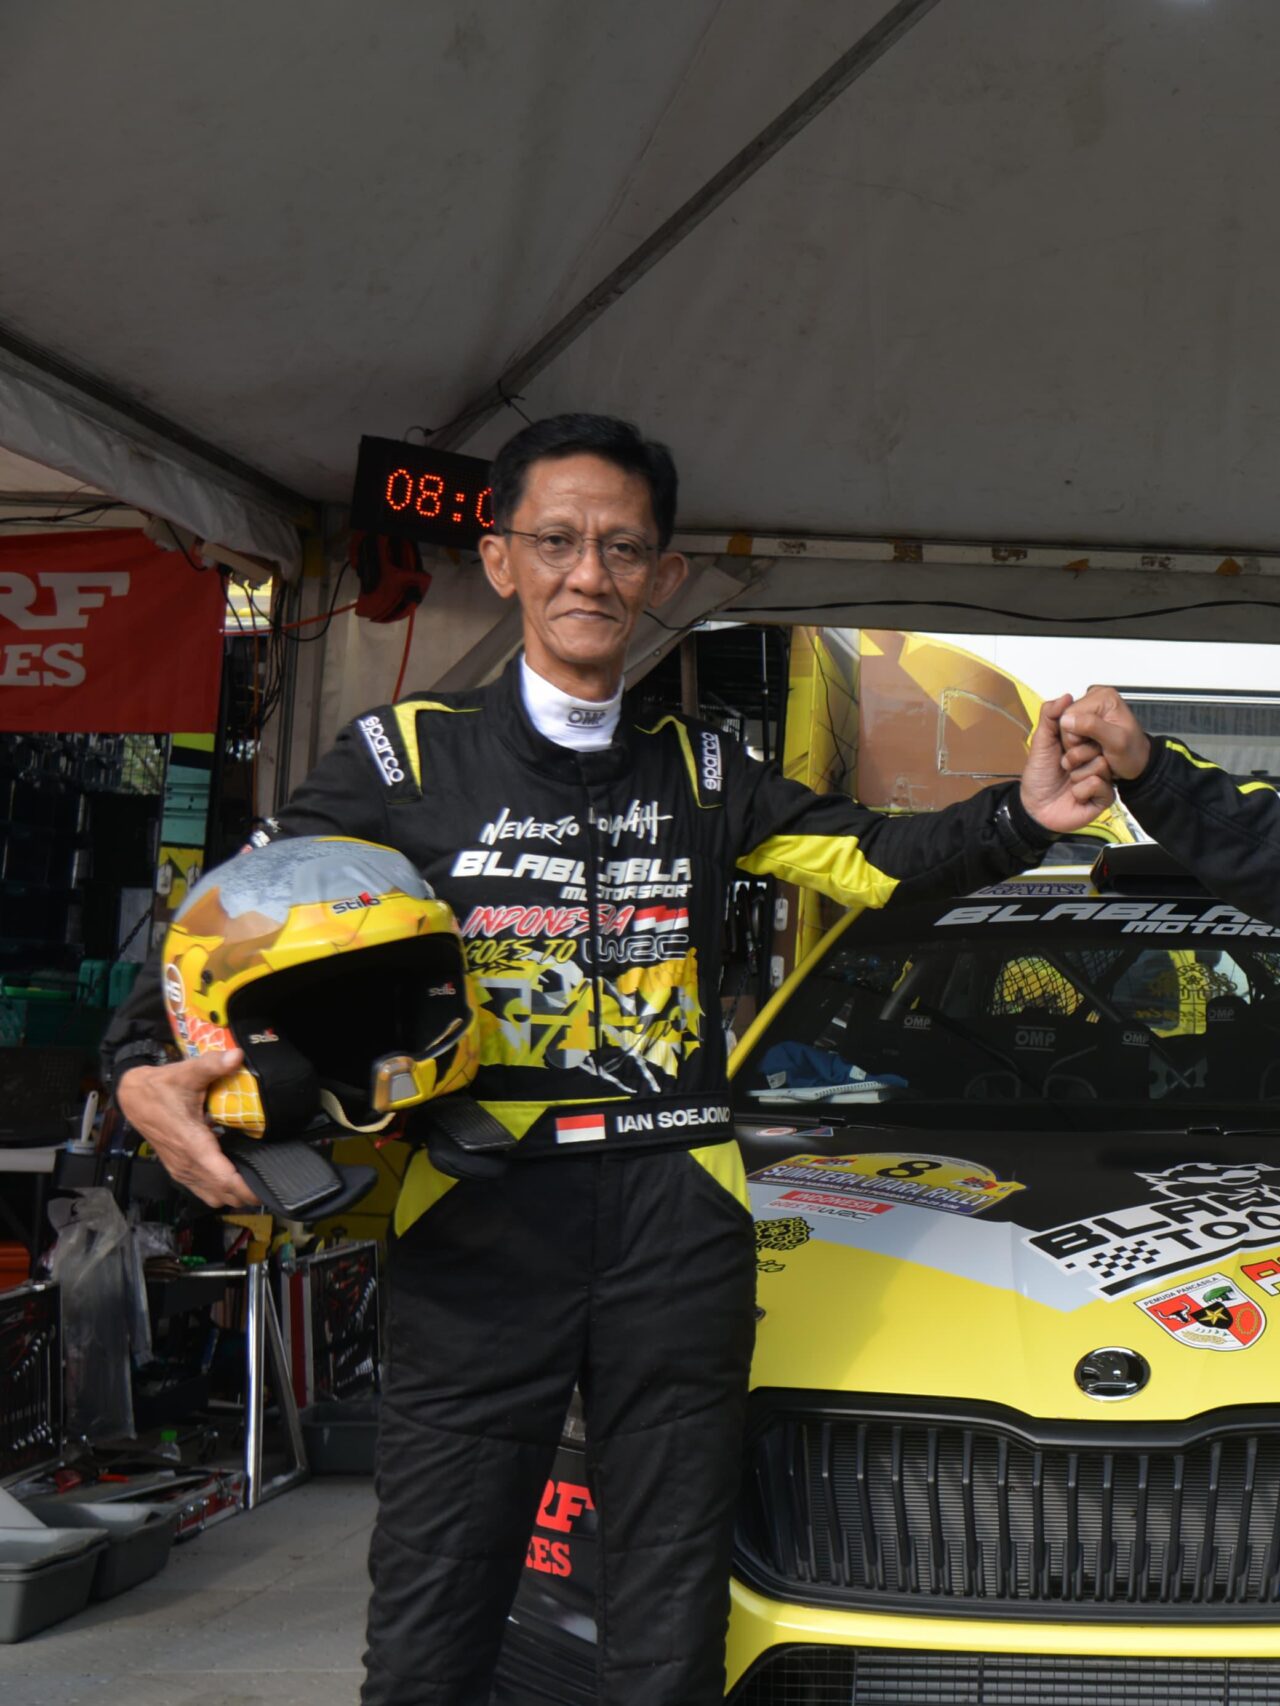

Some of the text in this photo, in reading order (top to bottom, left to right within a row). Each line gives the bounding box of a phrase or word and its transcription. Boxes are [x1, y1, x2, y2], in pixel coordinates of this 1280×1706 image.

[386, 468, 495, 528] 08:0
[0, 642, 87, 688] ES
[359, 714, 405, 786] sparco
[700, 731, 722, 791] sparco
[461, 904, 636, 938] INDONESIA
[542, 938, 578, 964] TO
[903, 1014, 932, 1029] OMP
[1014, 1029, 1056, 1048] OMP
[616, 1106, 731, 1134] IAN SOEJONO
[875, 1160, 943, 1179] 8
[763, 1165, 991, 1206] SUMATERA UTARA RALLY
[791, 1191, 878, 1211] INDONESIA
[1142, 1276, 1220, 1307] PEMUDA PANCASILA
